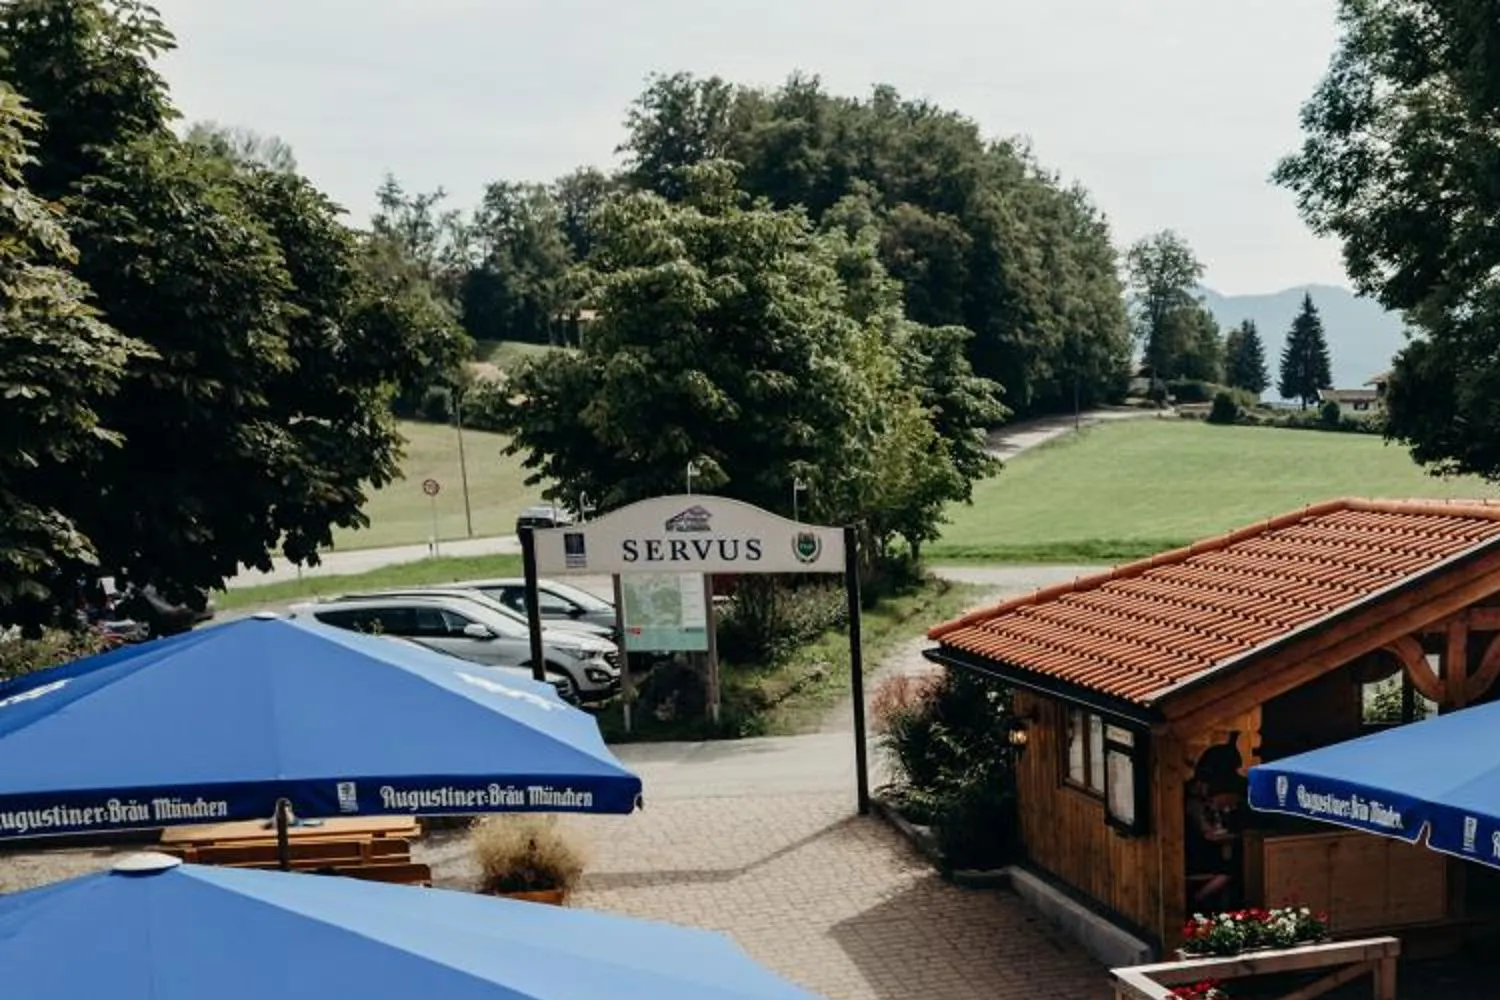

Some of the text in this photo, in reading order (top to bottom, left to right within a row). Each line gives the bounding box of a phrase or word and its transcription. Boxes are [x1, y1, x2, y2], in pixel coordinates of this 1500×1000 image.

[622, 538, 762, 562] SERVUS
[379, 783, 524, 811] Augustiner-Bräu
[526, 785, 594, 807] München
[0, 797, 228, 833] ugustiner-Bräu München
